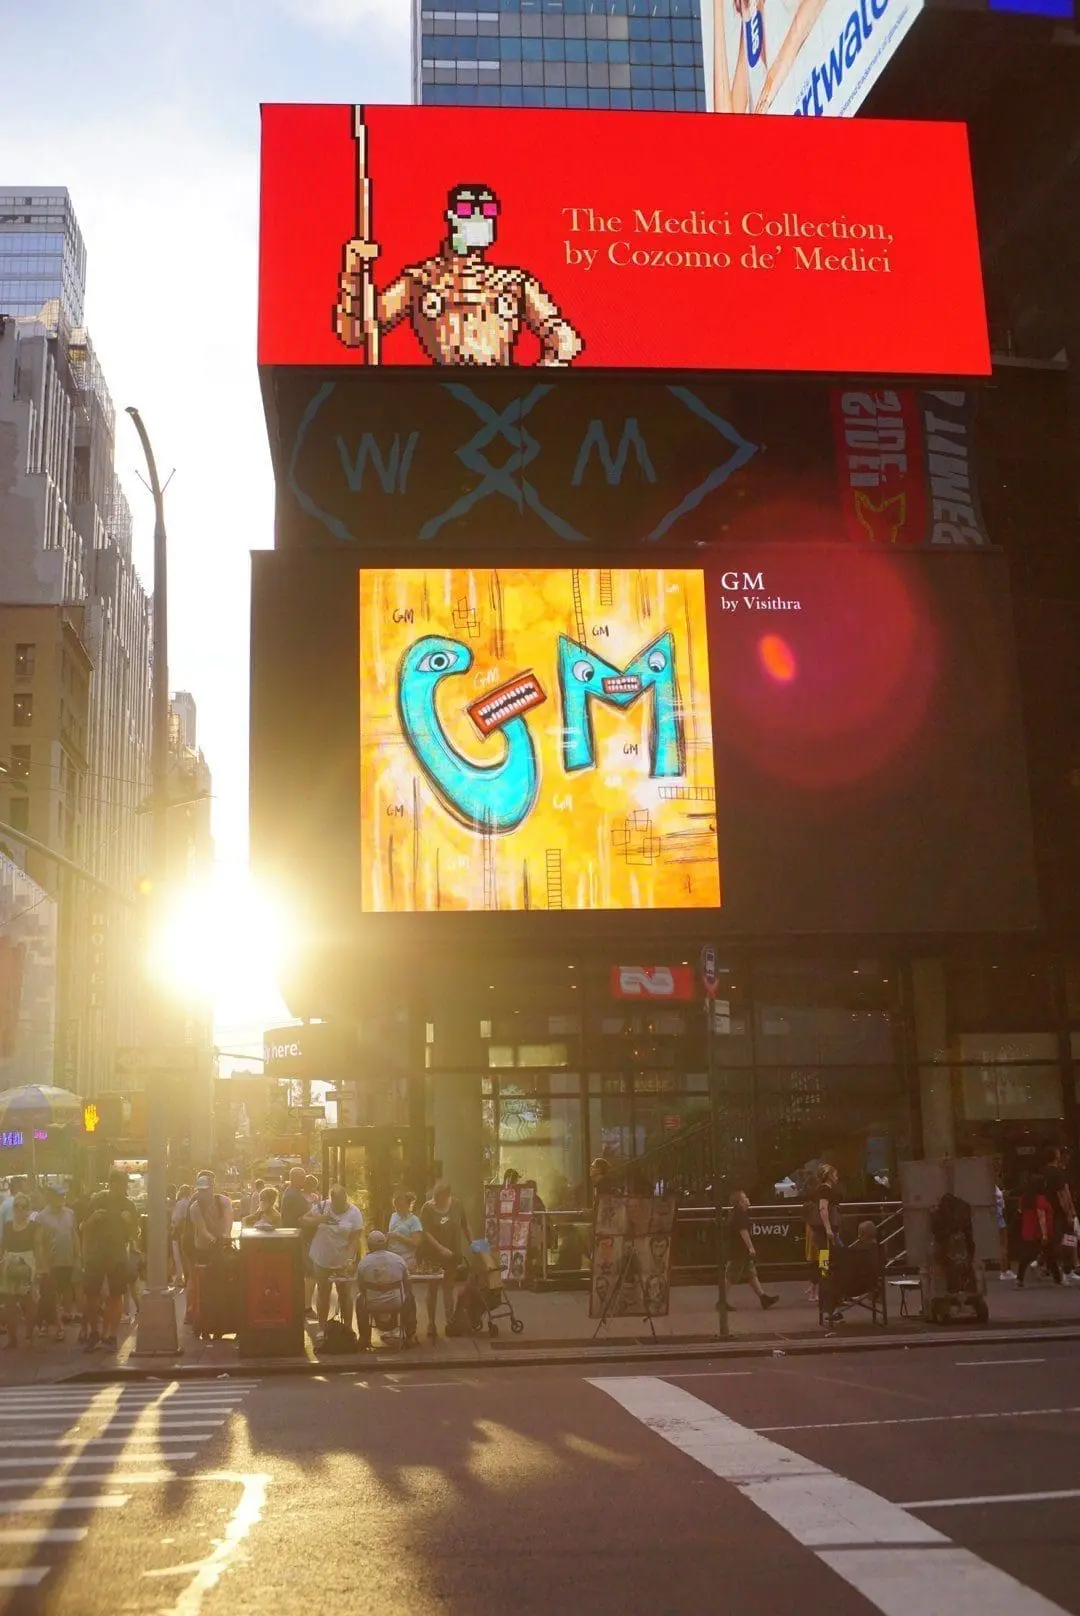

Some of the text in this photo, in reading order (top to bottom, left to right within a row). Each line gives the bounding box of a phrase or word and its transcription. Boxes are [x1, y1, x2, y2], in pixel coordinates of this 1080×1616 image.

[562, 207, 894, 244] The Medici Collection,
[563, 240, 599, 271] by
[607, 241, 731, 268] Cozomo
[794, 246, 892, 273] Medici
[721, 571, 765, 590] GM
[721, 596, 802, 612] by Visithra
[393, 608, 414, 624] GM
[592, 624, 609, 637] GM
[623, 744, 638, 756] GM
[386, 804, 405, 818] GM
[752, 1224, 790, 1237] bway
